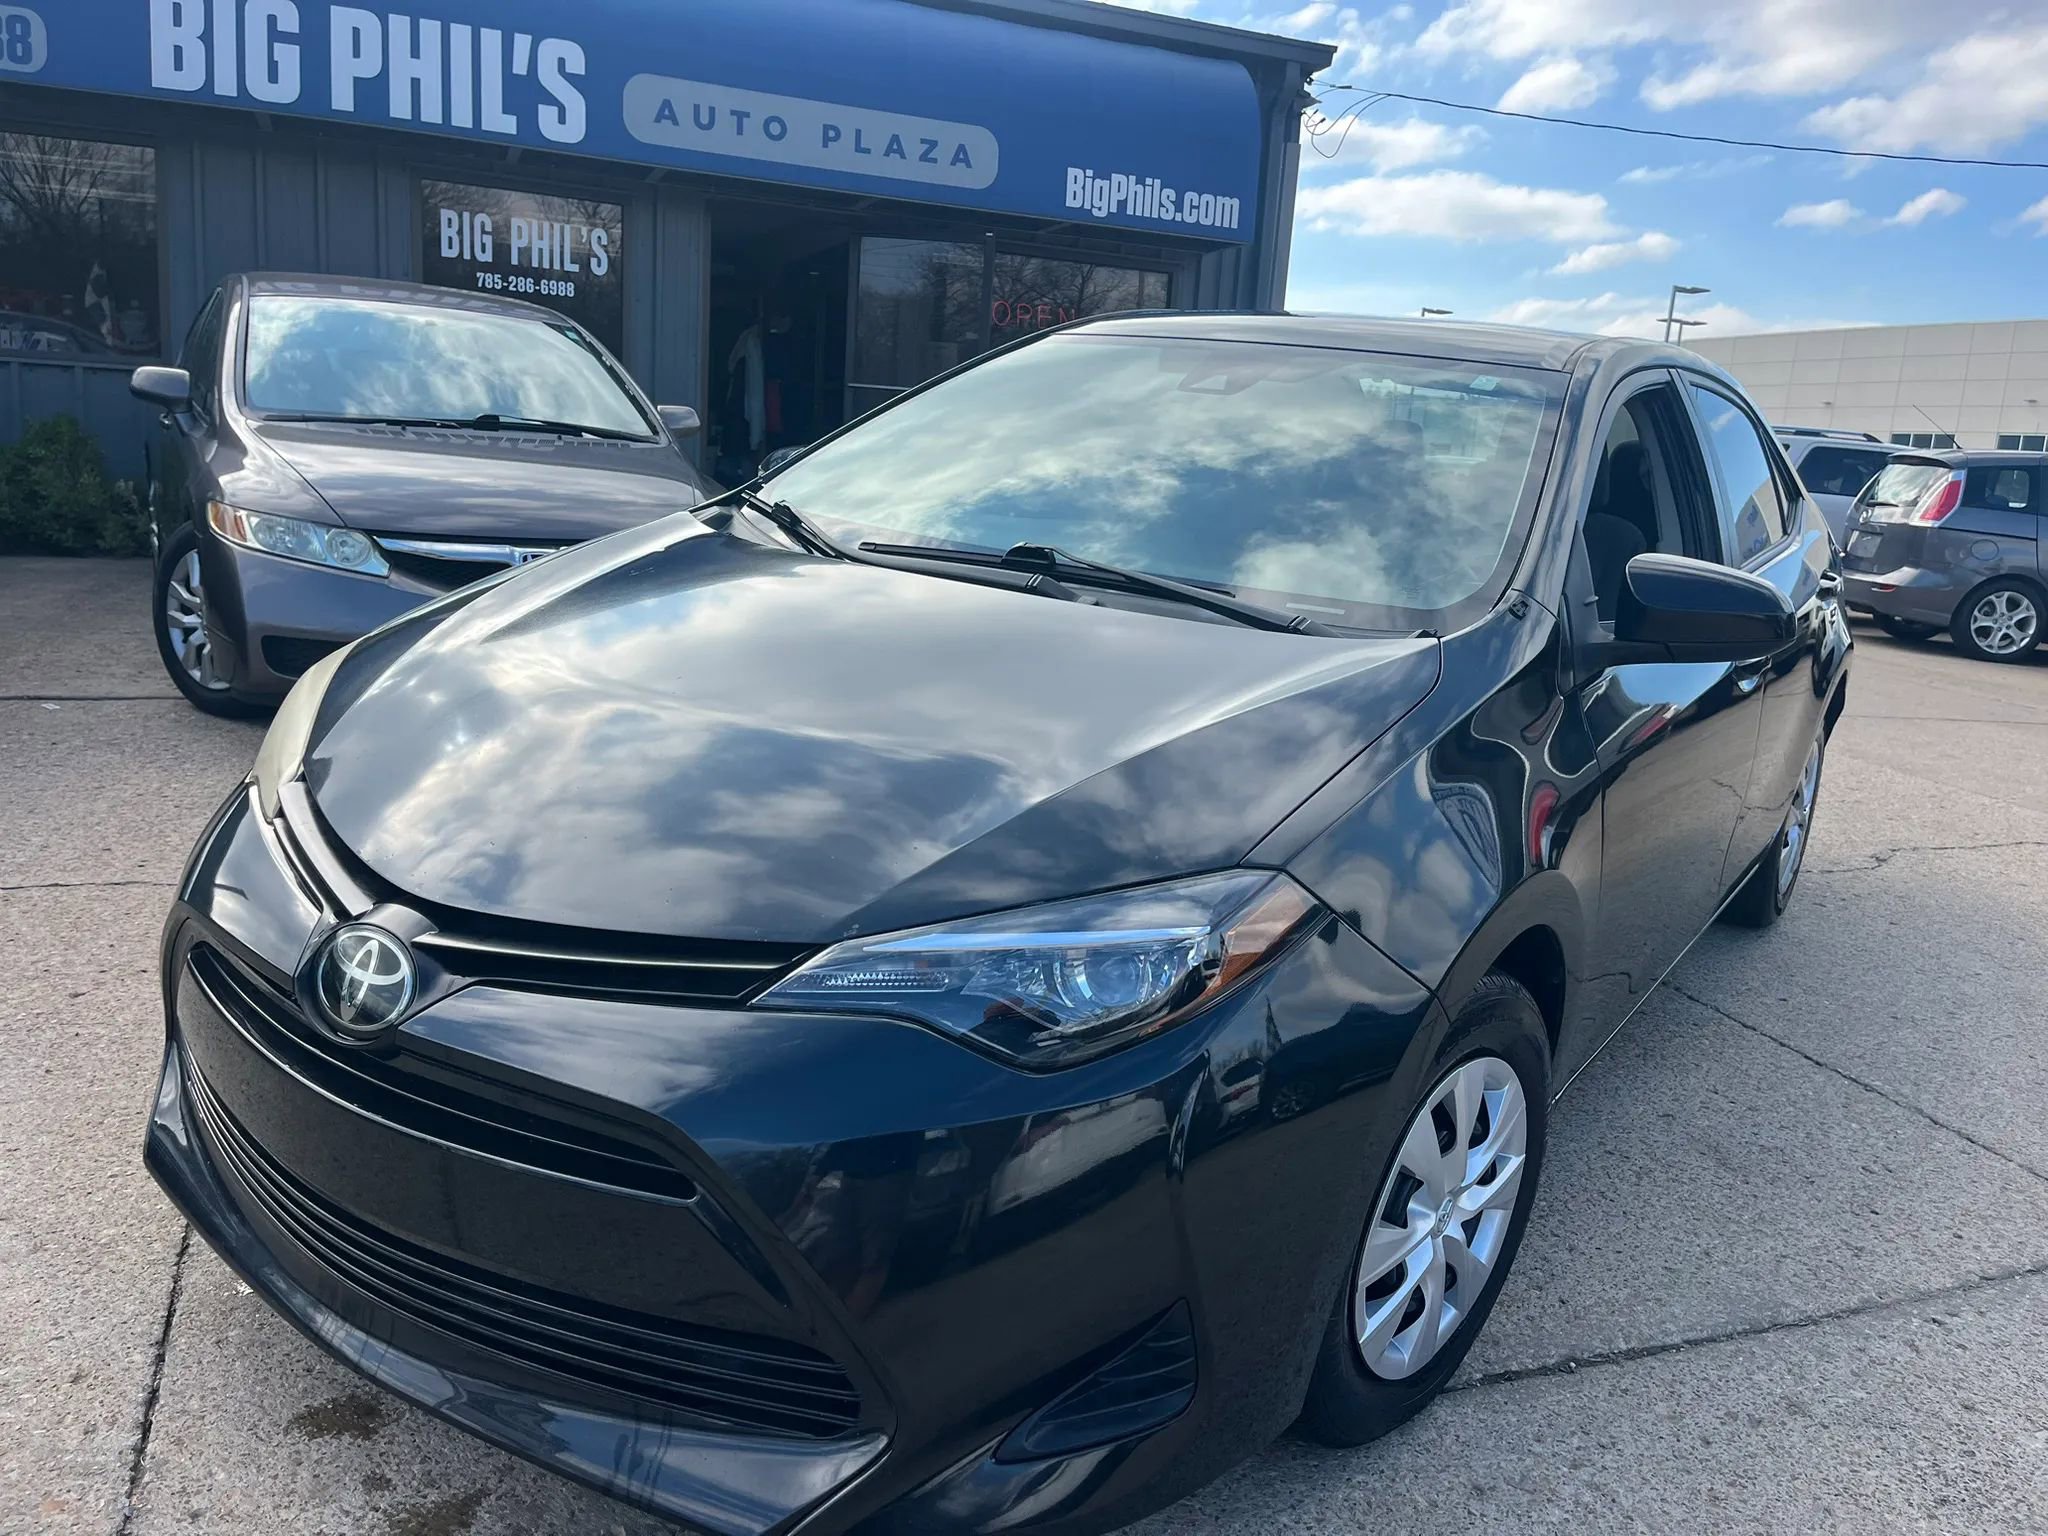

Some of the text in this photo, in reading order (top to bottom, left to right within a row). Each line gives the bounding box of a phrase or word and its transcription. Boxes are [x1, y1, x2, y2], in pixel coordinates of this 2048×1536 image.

[0, 14, 33, 65] 8
[149, 0, 587, 145] BIG PHIL'S
[653, 98, 973, 169] AUTO PLAZA
[1065, 166, 1240, 230] BigPhils.com
[440, 208, 609, 276] BIG PHIL'S
[476, 272, 575, 297] 785-286-6988
[992, 300, 1077, 329] OPEN
